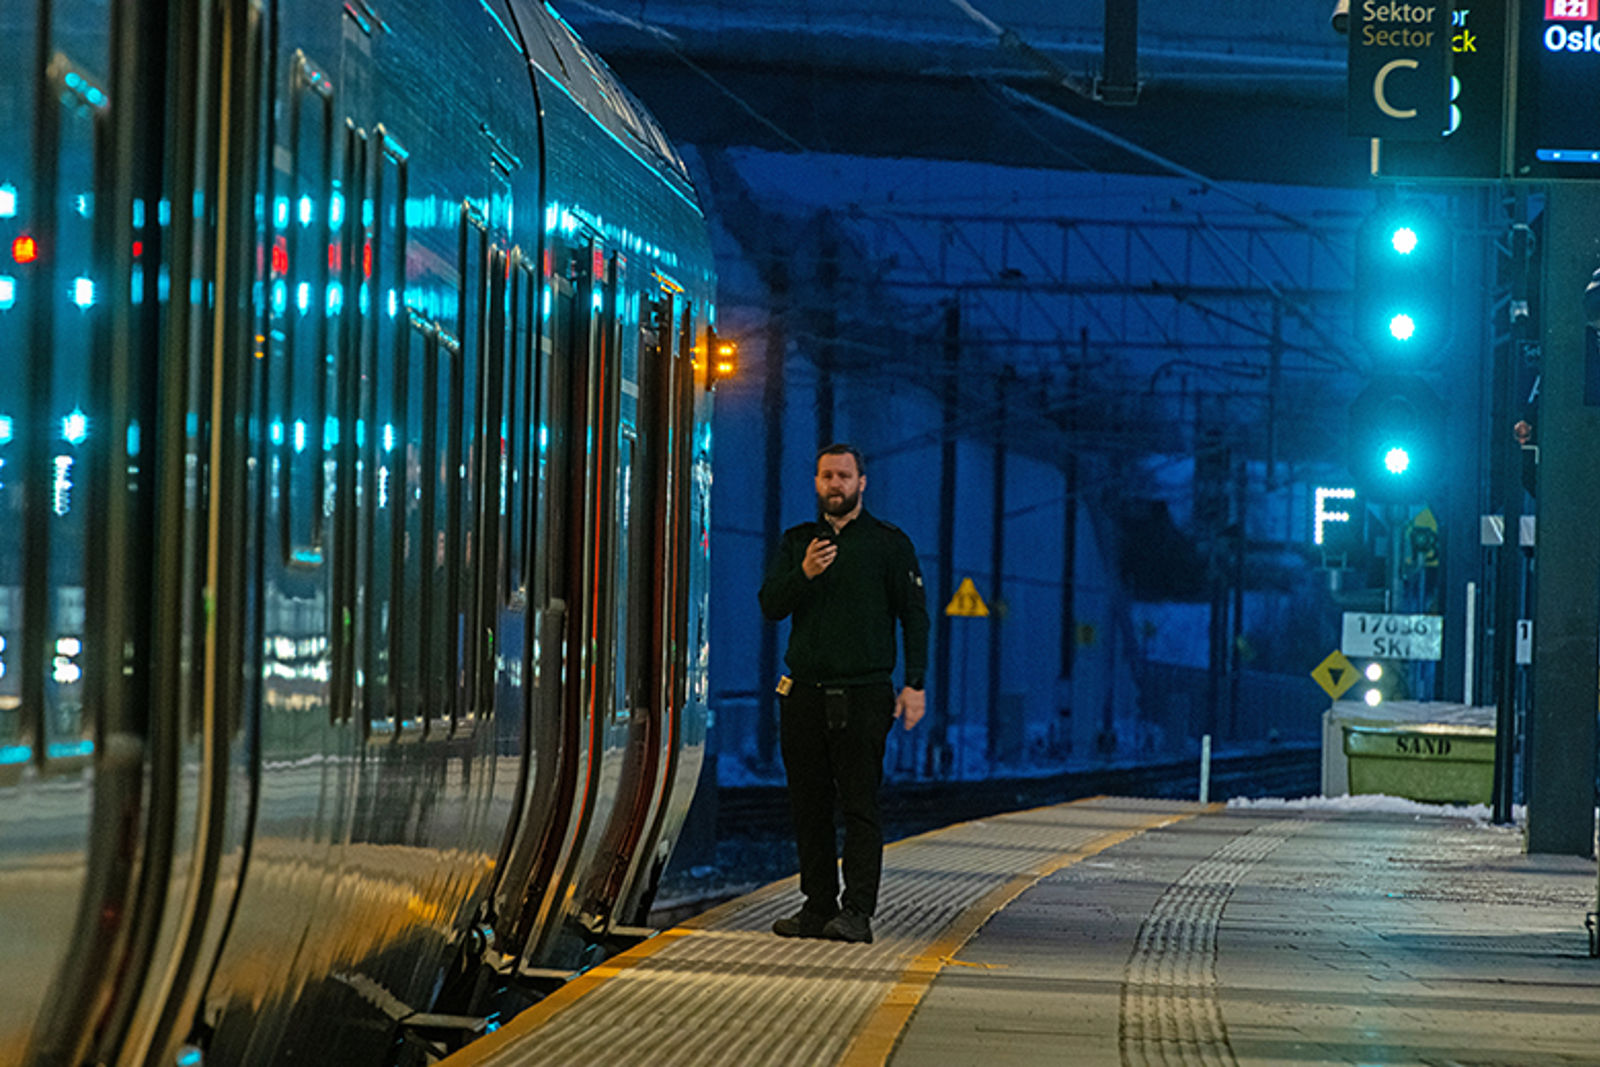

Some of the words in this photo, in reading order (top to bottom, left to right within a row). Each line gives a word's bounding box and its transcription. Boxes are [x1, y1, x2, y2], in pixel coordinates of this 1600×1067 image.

[1363, 0, 1435, 22] Sektor
[1362, 24, 1434, 47] Sector
[1374, 59, 1418, 118] C
[1314, 487, 1356, 545] F
[1396, 735, 1451, 755] SAND
